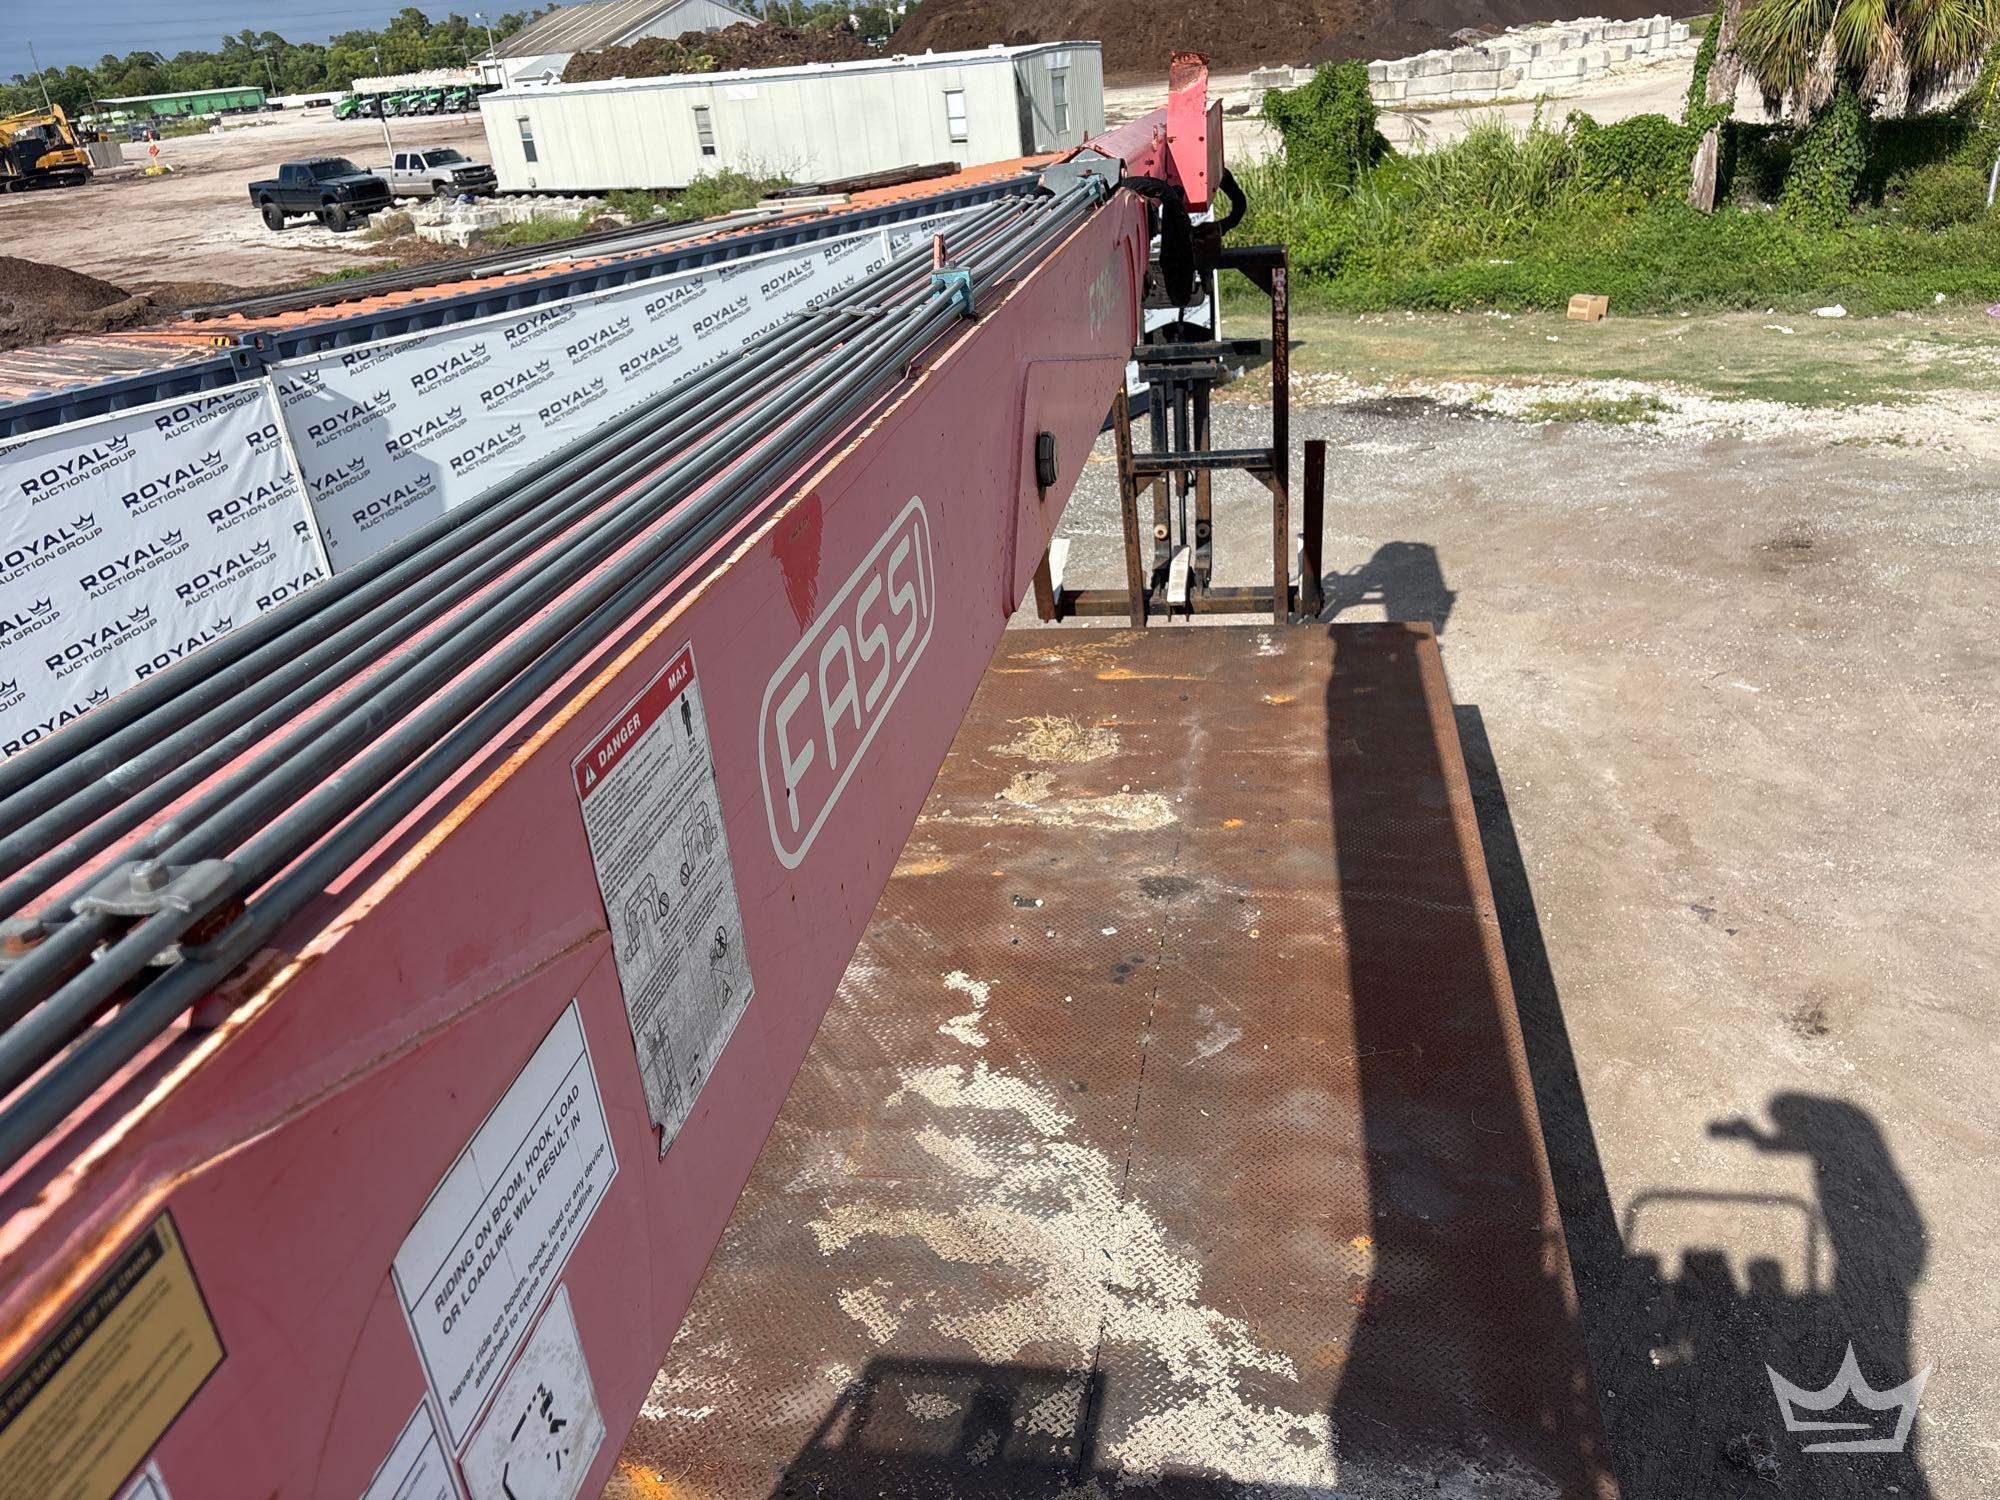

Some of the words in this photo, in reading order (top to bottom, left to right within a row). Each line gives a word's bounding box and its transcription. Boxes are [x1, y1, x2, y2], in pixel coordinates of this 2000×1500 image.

[824, 236, 862, 259] ROYAL
[645, 285, 694, 315] ROYAL
[761, 267, 801, 295] ROYAL
[765, 283, 792, 301] AUCTION
[806, 283, 846, 308] ROYAL
[504, 309, 560, 342] ROYAL
[650, 303, 682, 323] AUCTION
[682, 288, 707, 305] GROUP
[693, 303, 738, 334] ROYAL
[510, 327, 548, 350] AUCTION
[548, 311, 576, 330] GROUP
[566, 325, 619, 358] ROYAL
[572, 344, 607, 366] AUCTION
[607, 327, 634, 347] GROUP
[698, 320, 728, 341] AUCTION
[349, 350, 394, 377] AUCTION
[394, 336, 429, 354] GROUP
[410, 352, 472, 388] ROYAL
[418, 372, 460, 397] AUCTION
[460, 355, 491, 377] GROUP
[619, 343, 669, 375] ROYAL
[624, 361, 657, 383] AUCTION
[657, 346, 683, 365] GROUP
[288, 383, 326, 408] GROUP
[480, 369, 537, 404] ROYAL
[486, 388, 525, 412] AUCTION
[525, 371, 554, 390] GROUP
[538, 386, 592, 421] ROYAL
[154, 394, 235, 431] ROYAL
[164, 413, 217, 441] AUCTION
[219, 391, 259, 413] GROUP
[307, 400, 377, 440] ROYAL
[316, 421, 361, 448] AUCTION
[362, 403, 397, 425] GROUP
[544, 406, 580, 428] AUCTION
[581, 388, 608, 408] GROUP
[255, 437, 283, 456] AUCT
[385, 415, 449, 454] ROYAL
[392, 436, 435, 462] AUCTION
[435, 418, 467, 439] GROUP
[450, 431, 508, 470] ROYAL
[20, 448, 109, 496] ROYAL
[456, 453, 495, 478] AUCTION
[496, 435, 526, 455] GROUP
[31, 472, 90, 505] AUCTION
[91, 449, 136, 475] GROUP
[121, 463, 204, 508] ROYAL
[132, 485, 186, 518] AUCTION
[187, 464, 229, 489] GROUP
[311, 466, 350, 491] YAL
[335, 469, 371, 492] GROUP
[207, 480, 283, 524] ROYAL
[216, 502, 267, 533] AUCTION
[269, 487, 299, 506] GROU
[352, 484, 417, 524] ROYAL
[360, 505, 403, 532] AUCTION
[404, 485, 437, 508] GROUP
[57, 527, 102, 555] GROUP
[79, 542, 164, 591] ROYAL
[90, 566, 145, 600] AUCTION
[149, 543, 190, 569] GROUP
[175, 553, 254, 599] ROYAL
[184, 576, 237, 608] AUCTION
[238, 553, 277, 578] GROUP
[256, 566, 325, 611] ROYAL
[13, 611, 61, 641] GROUP
[45, 620, 131, 671] ROYAL
[56, 643, 113, 680] AUCTION
[114, 616, 158, 646] GROUP
[135, 631, 215, 680] ROYAL
[668, 662, 688, 691] MAX
[776, 521, 928, 833] FASSI
[0, 692, 26, 712] OUP
[2, 703, 91, 757] ROYAL
[598, 713, 641, 768] DANGER
[434, 1249, 475, 1314] RIDING
[474, 1221, 492, 1251] ON
[492, 1171, 526, 1227] BOOM,
[525, 1125, 556, 1173] HOOK,
[555, 1085, 579, 1124] LOAD
[442, 1304, 461, 1335] OR
[462, 1220, 515, 1305] LOADLINE
[513, 1185, 537, 1221] WILL
[537, 1129, 573, 1185] RESULT
[571, 1110, 581, 1131] IN
[449, 1364, 475, 1407] Never
[476, 1334, 492, 1364] ride
[492, 1312, 504, 1335] on
[504, 1277, 528, 1314] boom,
[527, 1240, 550, 1273] hook,
[548, 1207, 564, 1238] load
[563, 1198, 573, 1213] or
[572, 1178, 585, 1200] any
[585, 1143, 605, 1177] device
[474, 1326, 510, 1390] attached
[509, 1311, 519, 1330] to
[519, 1277, 540, 1313] crane
[540, 1241, 561, 1278] boom
[559, 1225, 568, 1241] or
[567, 1183, 595, 1227] loadline.
